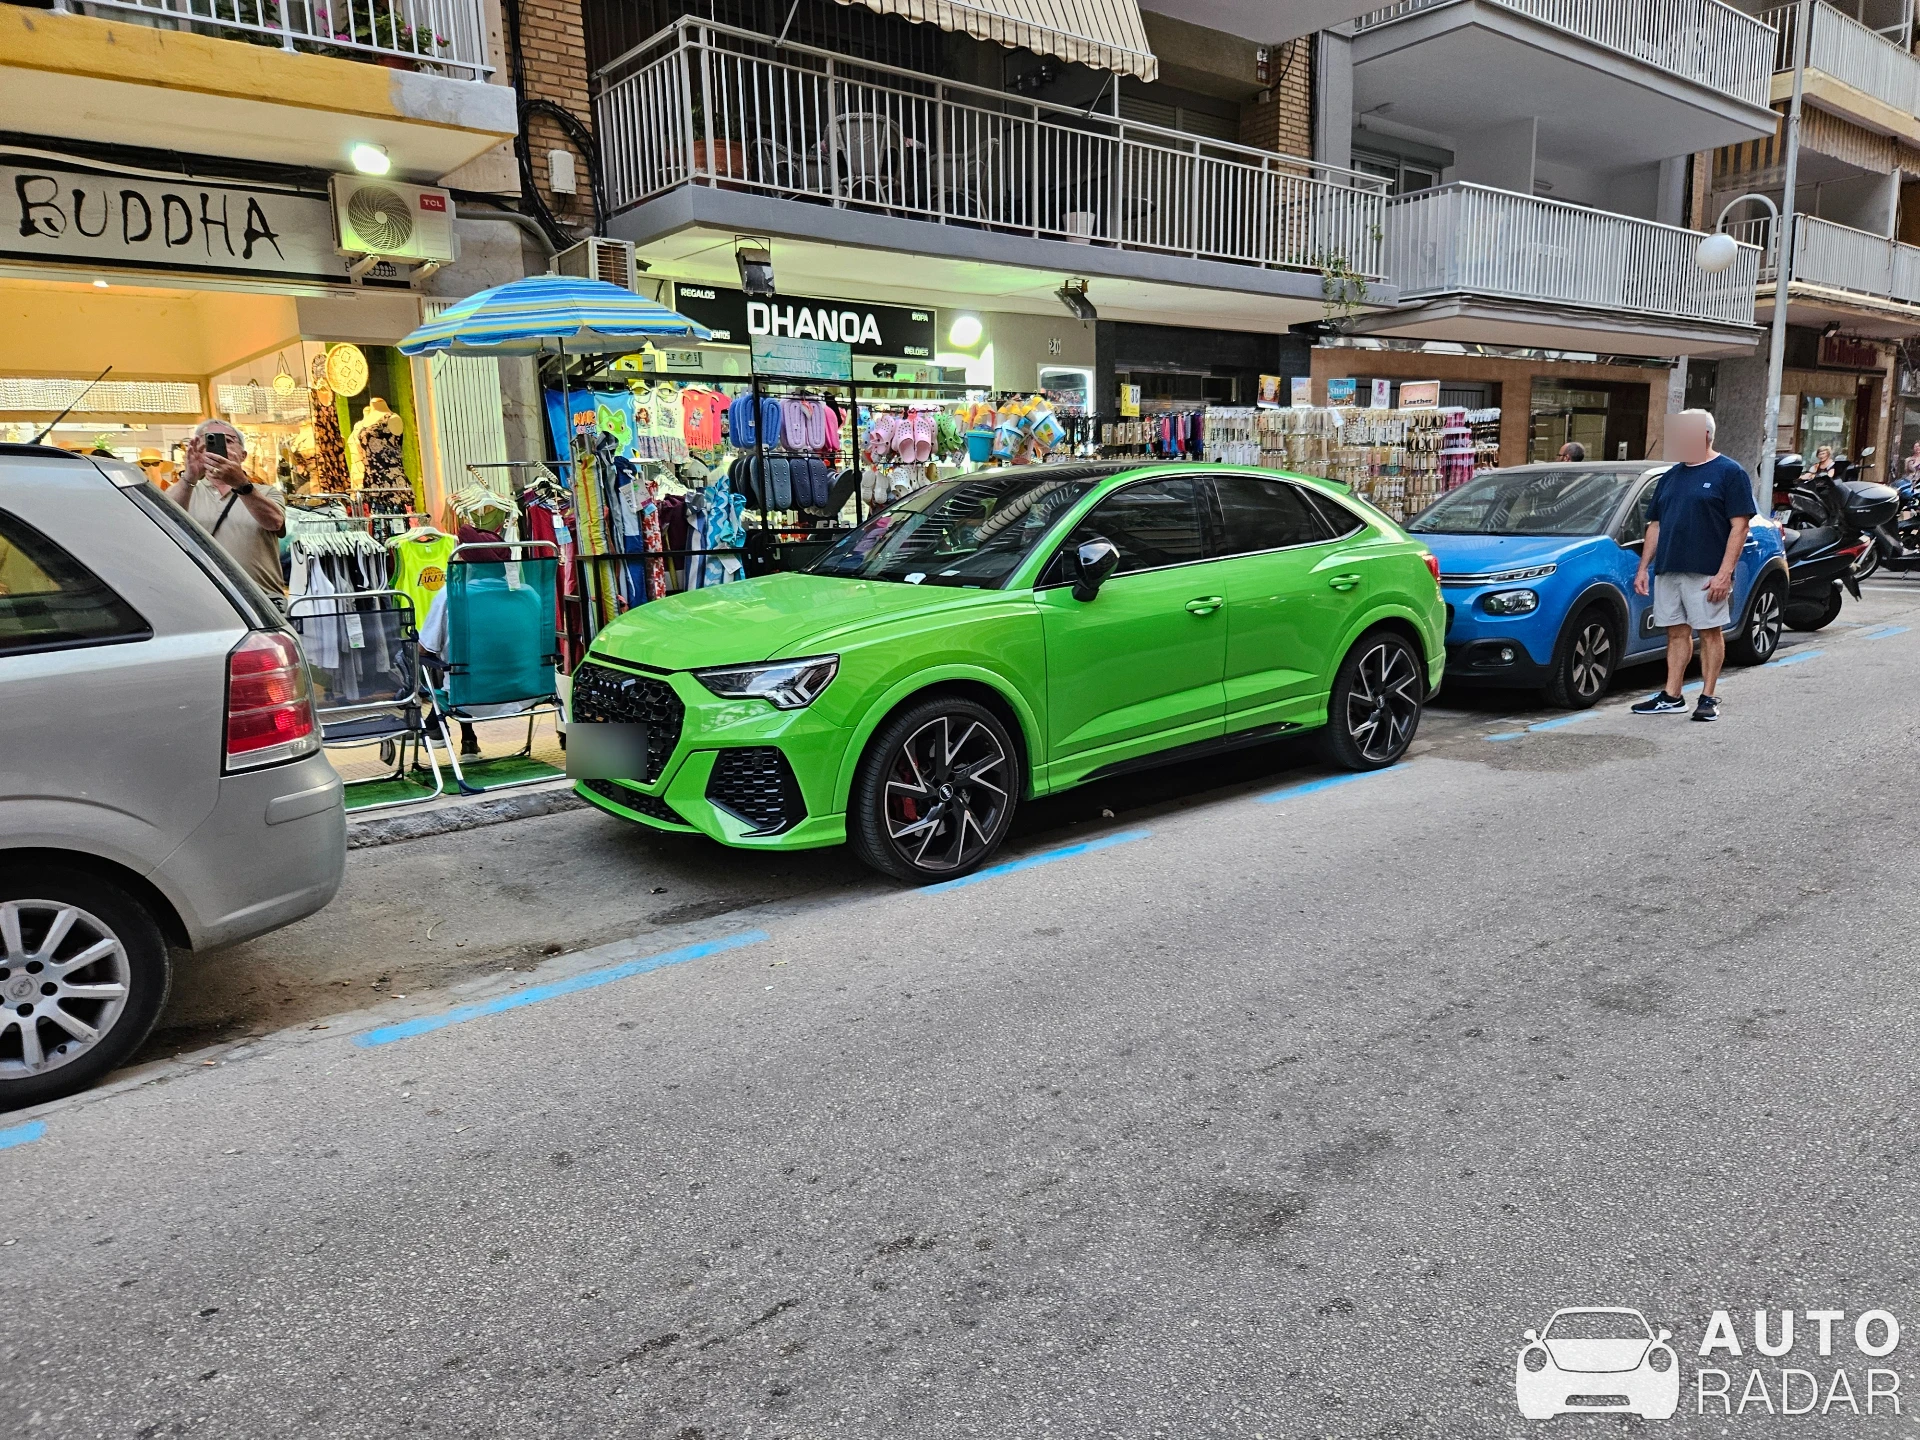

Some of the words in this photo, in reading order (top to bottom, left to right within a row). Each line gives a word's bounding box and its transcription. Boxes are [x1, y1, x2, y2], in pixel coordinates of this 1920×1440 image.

[423, 198, 443, 208] TCL
[15, 174, 285, 261] BUDDHA
[680, 287, 716, 300] REGALOS
[911, 311, 929, 322] ROPA
[746, 301, 883, 346] DHANOA
[710, 328, 731, 340] ENTOS
[903, 345, 929, 357] RELOJES
[1048, 338, 1061, 356] 20
[573, 410, 597, 427] NAR
[417, 573, 448, 587] LAKER
